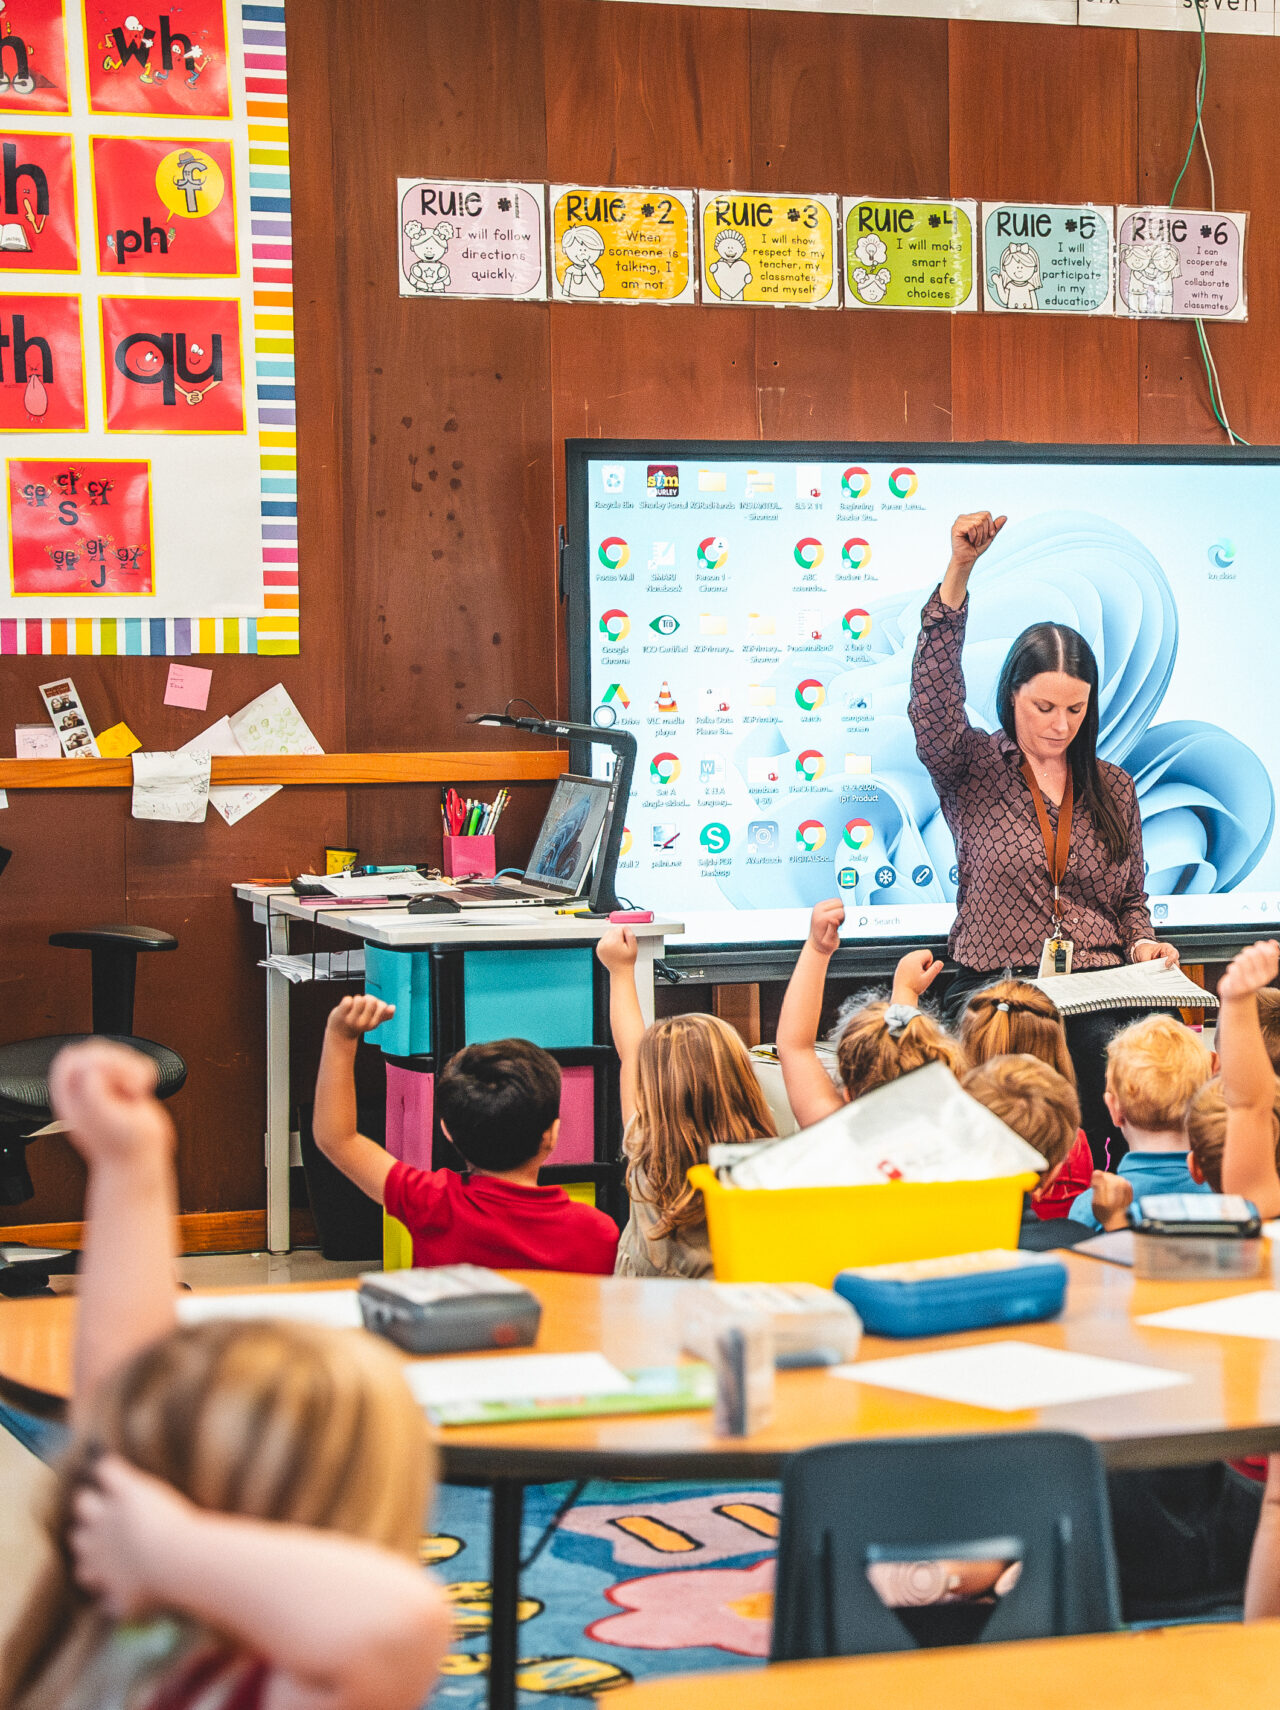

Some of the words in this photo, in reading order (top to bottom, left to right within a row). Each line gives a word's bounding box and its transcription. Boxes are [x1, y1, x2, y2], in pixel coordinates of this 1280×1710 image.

[112, 15, 196, 71] wh
[421, 188, 483, 217] Rule
[567, 195, 626, 222] Rule
[641, 200, 675, 225] #2
[715, 200, 773, 227] Rule
[787, 204, 819, 229] #3
[858, 205, 915, 233] Rule
[996, 211, 1052, 238] Rule
[1064, 215, 1096, 240] #5
[456, 227, 462, 239] I
[468, 228, 488, 240] will
[493, 228, 531, 242] follow
[626, 230, 662, 243] When
[1131, 215, 1188, 242] Rule
[1200, 222, 1228, 245] #6
[116, 216, 169, 265] ph
[761, 234, 767, 244] I
[771, 234, 788, 245] will
[896, 238, 903, 249] I
[908, 238, 927, 251] will
[461, 246, 526, 261] directions
[608, 248, 664, 258] someone
[668, 247, 679, 258] is
[753, 247, 792, 259] respect
[796, 248, 806, 257] to
[810, 250, 825, 260] my
[1058, 241, 1064, 253] I
[1068, 242, 1085, 254] will
[1196, 246, 1202, 256] I
[1204, 248, 1219, 256] can
[616, 261, 661, 275] talking,
[666, 261, 673, 273] I
[759, 260, 802, 270] teacher,
[805, 262, 820, 272] my
[911, 257, 947, 268] smart
[1051, 257, 1092, 269] actively
[1186, 258, 1228, 268] cooperate
[471, 266, 518, 282] quickly.
[904, 273, 925, 284] and
[929, 273, 956, 284] safe
[1200, 268, 1215, 277] and
[621, 281, 640, 290] am
[761, 284, 779, 293] and
[1058, 283, 1066, 293] in
[1070, 286, 1086, 296] my
[1184, 278, 1230, 289] collaborate
[1192, 291, 1207, 300] with
[1211, 293, 1224, 302] my
[114, 332, 223, 406] qu
[852, 794, 879, 802] Product
[874, 917, 901, 926] Search
